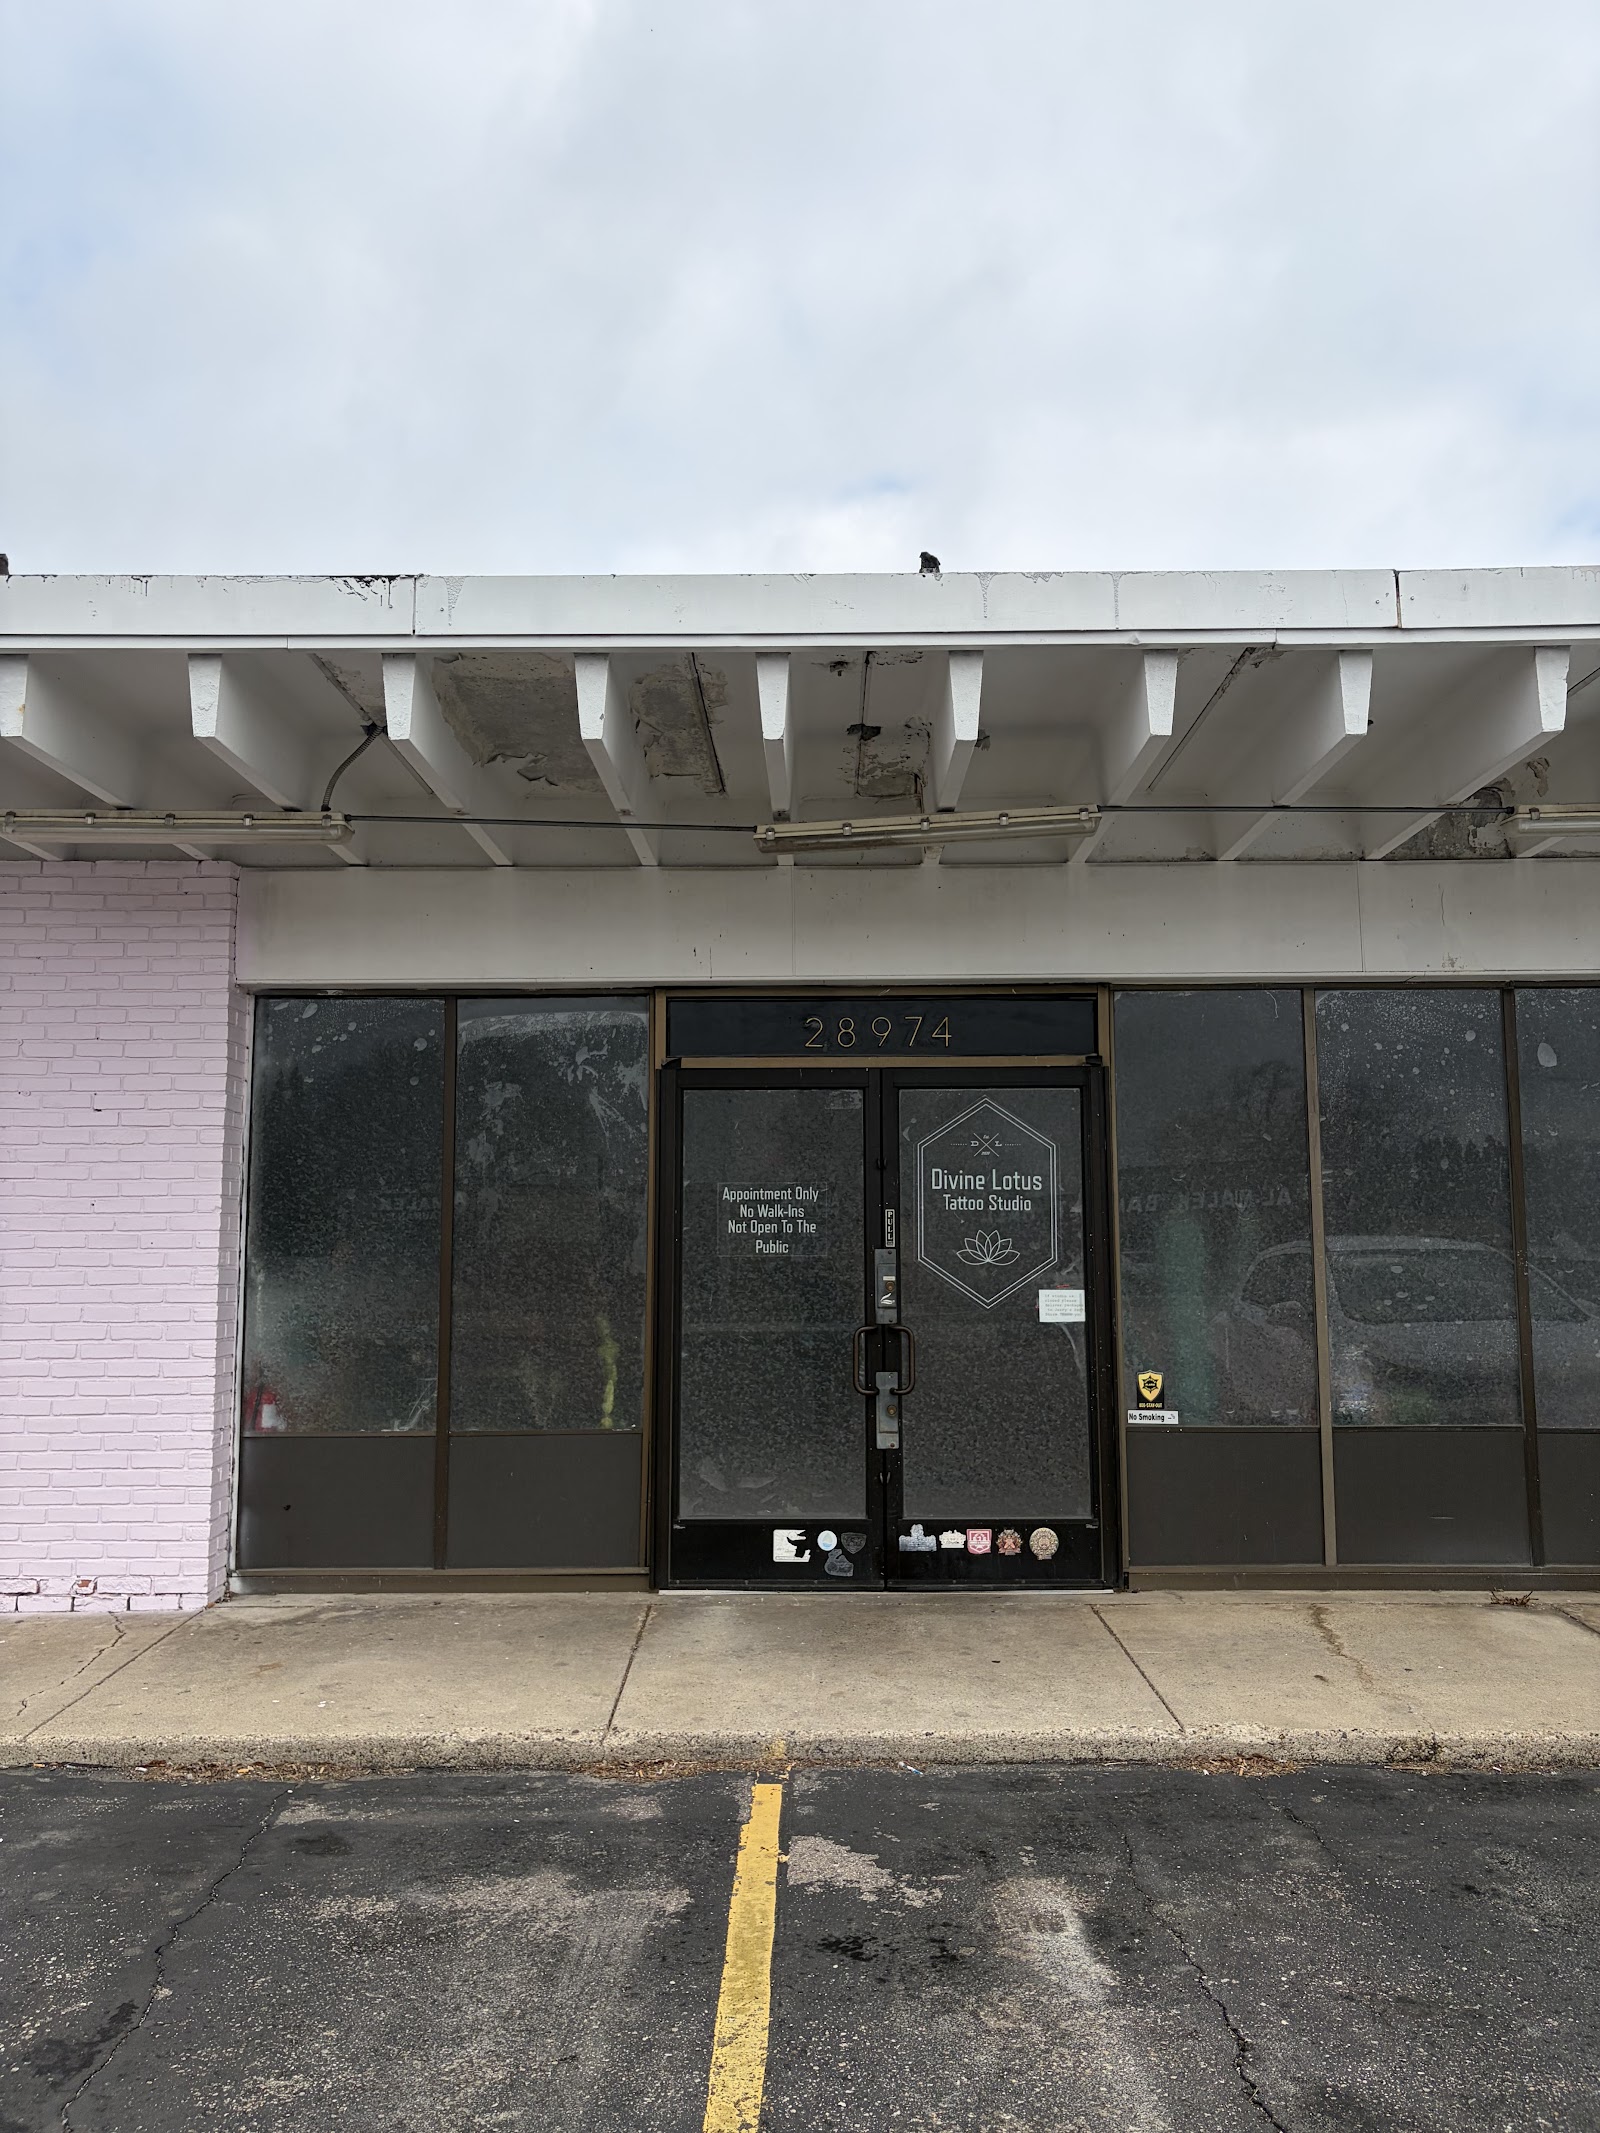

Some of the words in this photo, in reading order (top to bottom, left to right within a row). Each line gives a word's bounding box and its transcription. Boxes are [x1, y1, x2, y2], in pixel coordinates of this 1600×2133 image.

[805, 1017, 952, 1048] 28974
[931, 1169, 985, 1191] Divine
[992, 1169, 1043, 1191] Lotus
[722, 1187, 792, 1203] Appointment
[796, 1187, 819, 1203] Only
[943, 1194, 984, 1211] Tattoo
[989, 1194, 1032, 1211] Studio
[740, 1204, 754, 1218] No
[758, 1204, 805, 1218] Walk-Ins
[728, 1220, 747, 1234] Not
[751, 1220, 778, 1236] Open
[781, 1220, 793, 1234] To
[796, 1220, 816, 1233] The
[755, 1240, 789, 1254] Public
[1129, 1413, 1137, 1421] No
[1139, 1413, 1165, 1422] Smoking
